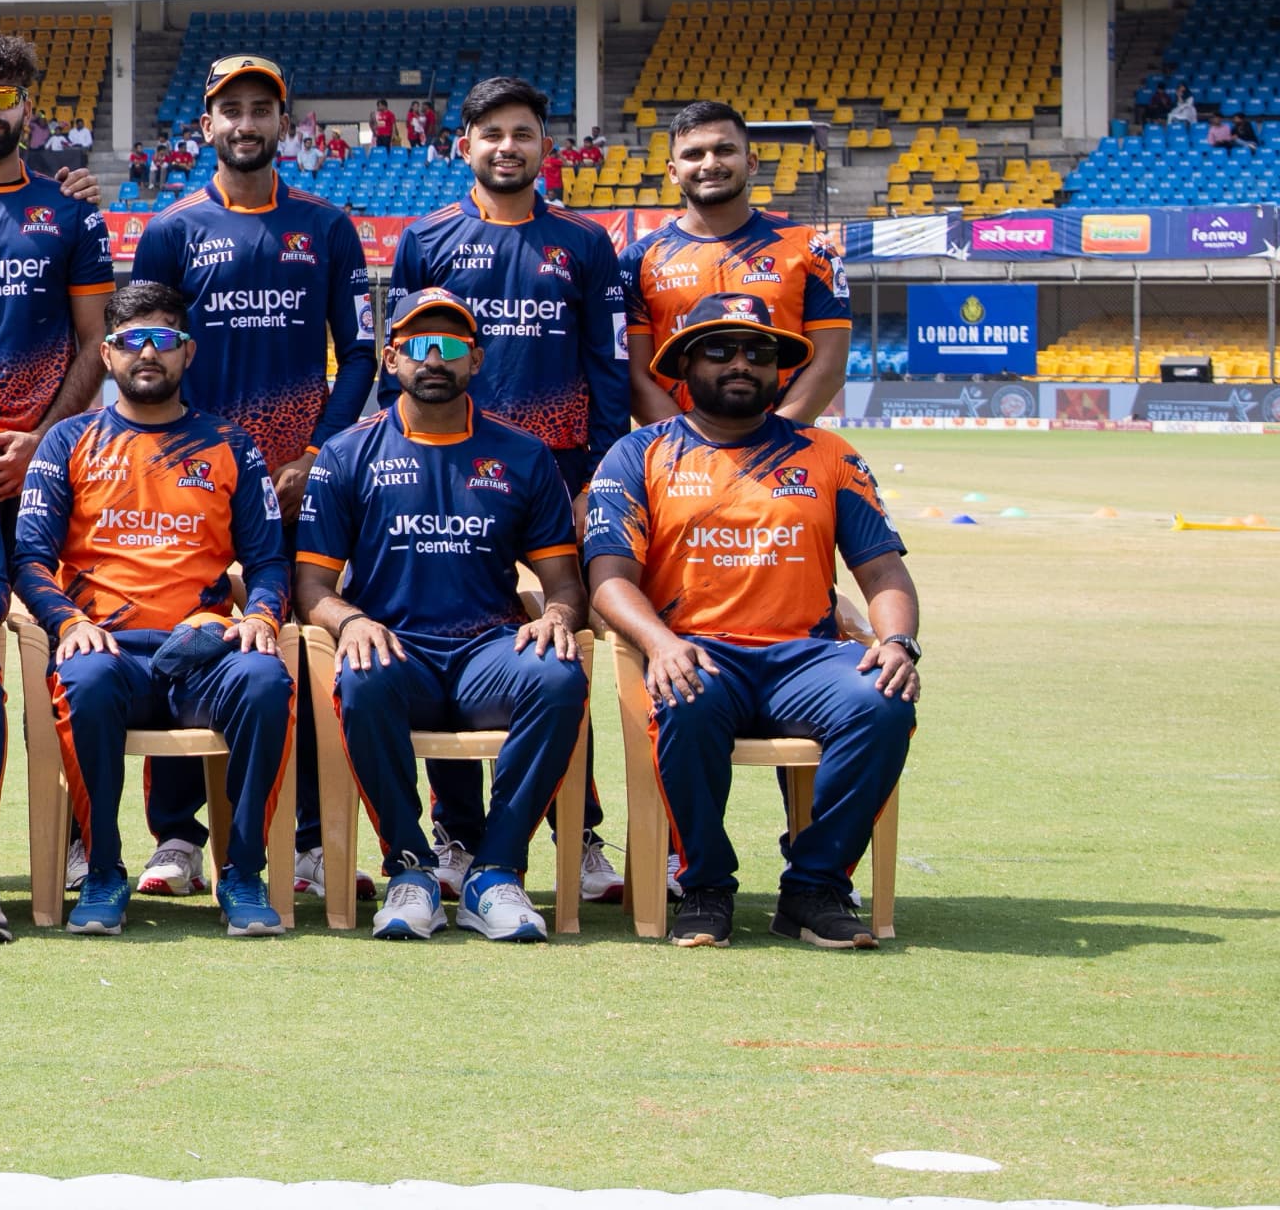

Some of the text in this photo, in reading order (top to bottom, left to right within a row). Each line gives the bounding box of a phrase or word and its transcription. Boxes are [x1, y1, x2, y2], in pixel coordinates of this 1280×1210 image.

[23, 223, 59, 235] CHEETAHS
[1191, 228, 1248, 245] fenway
[190, 237, 235, 253] VISWA
[191, 251, 233, 268] KIRTI
[281, 252, 315, 264] CHEETAHS
[452, 258, 491, 269] KIRTI
[650, 262, 699, 278] VISWA
[656, 275, 698, 292] KIRTI
[743, 273, 781, 284] CHEETAHS
[204, 290, 305, 315] JKsuper
[230, 313, 286, 328] cement
[482, 324, 541, 336] cement
[917, 326, 1029, 343] LONDON PRIDE
[882, 409, 960, 418] SITAAREIN
[1147, 410, 1228, 421] SITAAREIN
[369, 457, 420, 474] VISWA
[178, 478, 214, 491] CHEETAHS
[373, 472, 418, 487] KIRTI
[470, 478, 508, 492] CHEETAHS
[667, 484, 712, 498] KIRTI
[773, 487, 816, 498] CHEETAHS
[96, 508, 204, 534] JKsuper
[389, 514, 495, 540] JKsuper
[118, 532, 179, 547] cement
[416, 540, 471, 554] cement
[686, 524, 803, 555] JKsuper
[712, 550, 778, 567] cement
